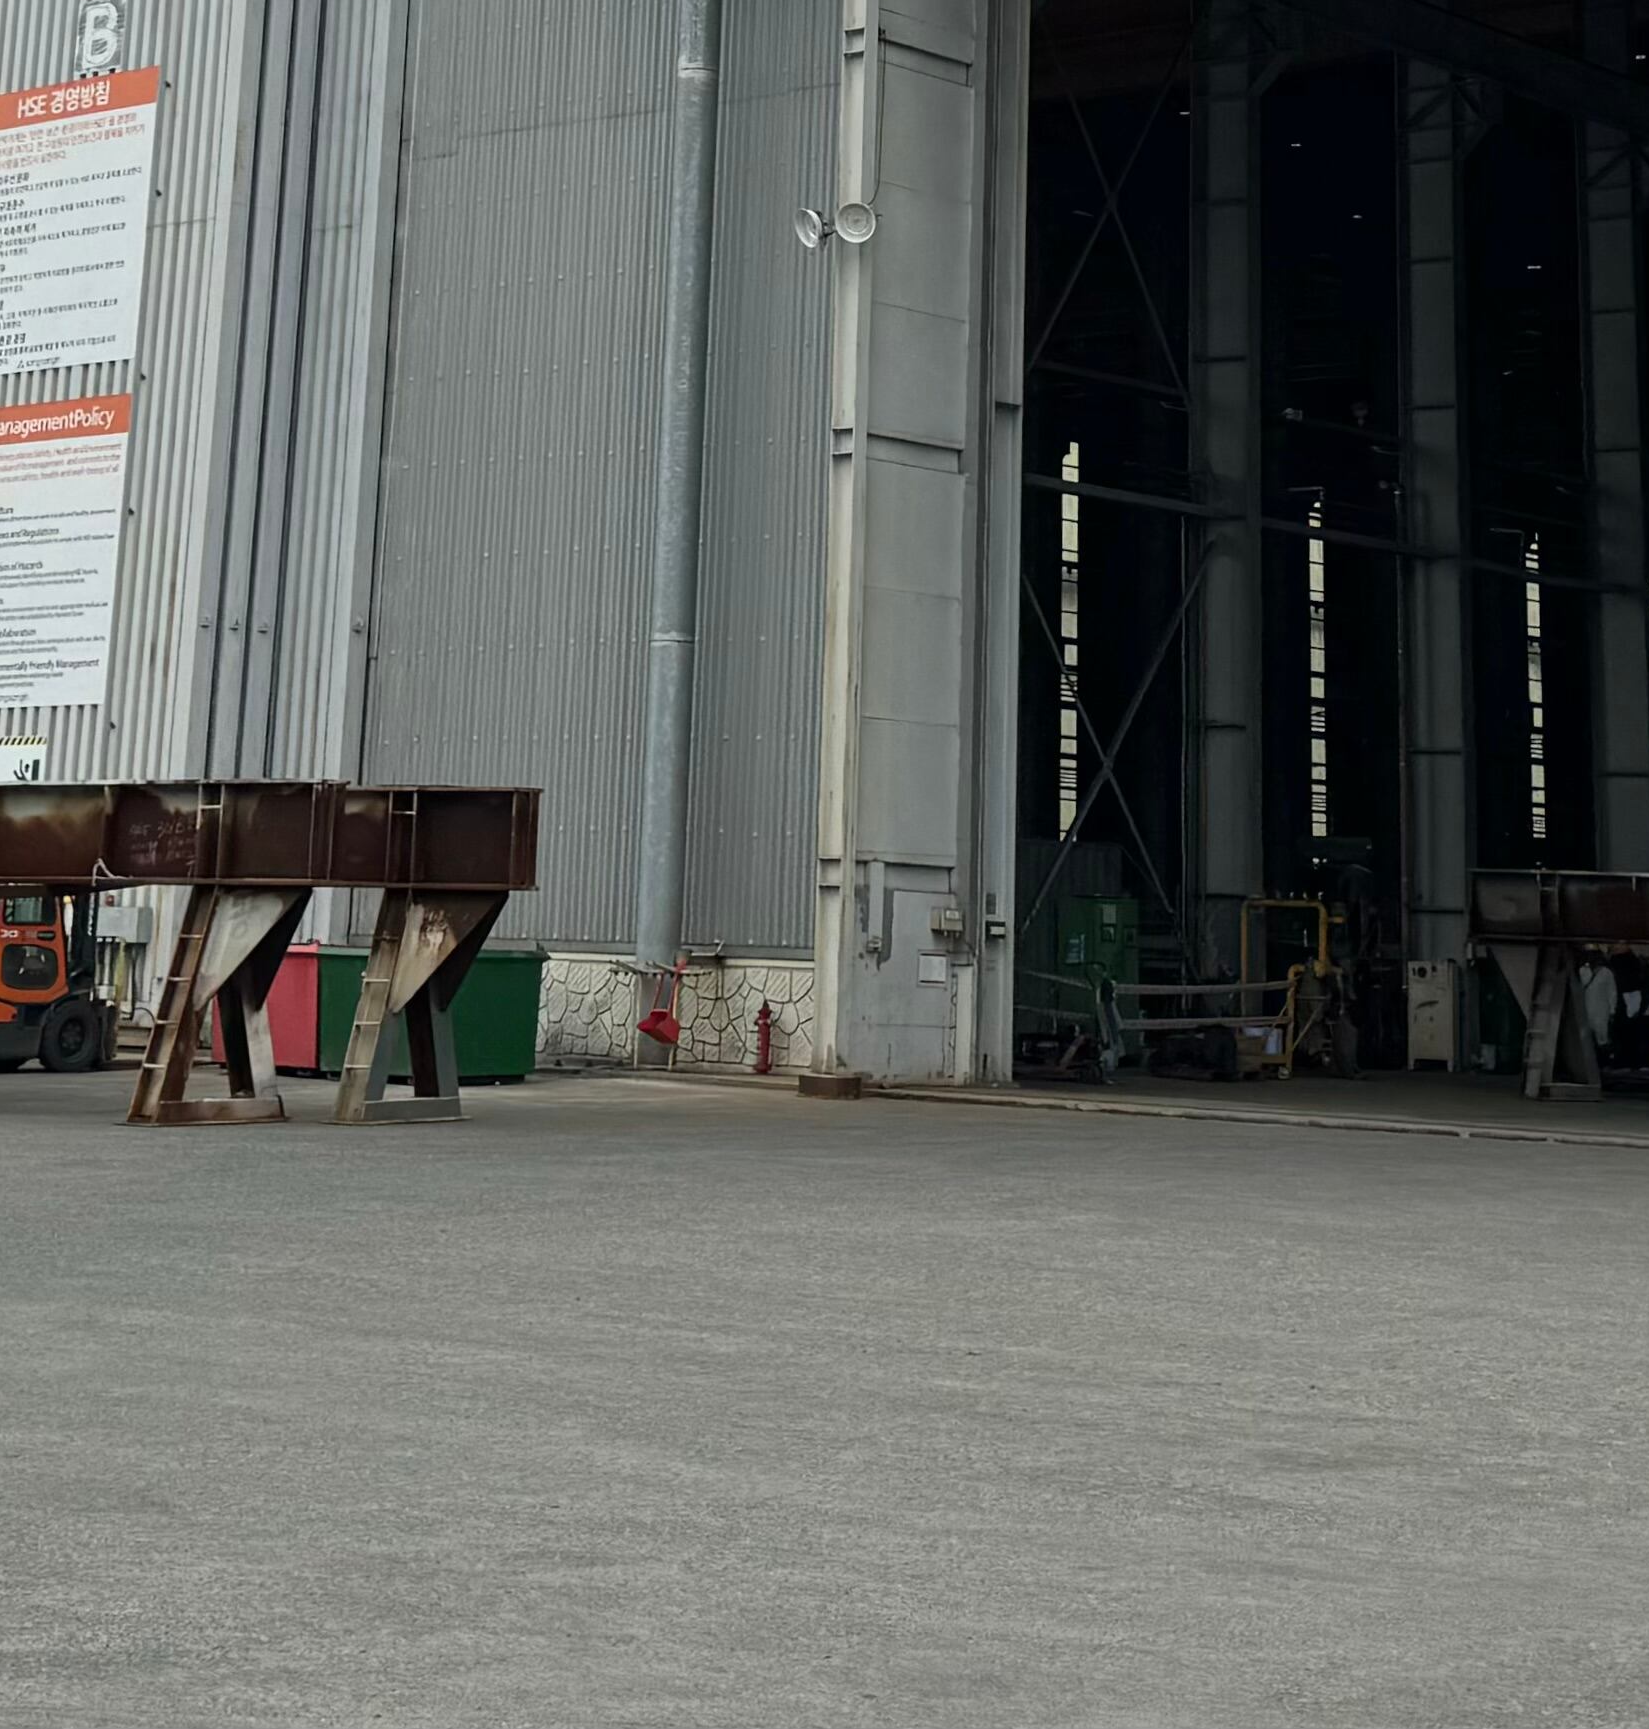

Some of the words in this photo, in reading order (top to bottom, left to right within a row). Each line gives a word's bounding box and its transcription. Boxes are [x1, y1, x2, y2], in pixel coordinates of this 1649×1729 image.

[83, 2, 118, 68] B
[16, 92, 47, 119] HSE
[49, 79, 110, 114] 경영방침
